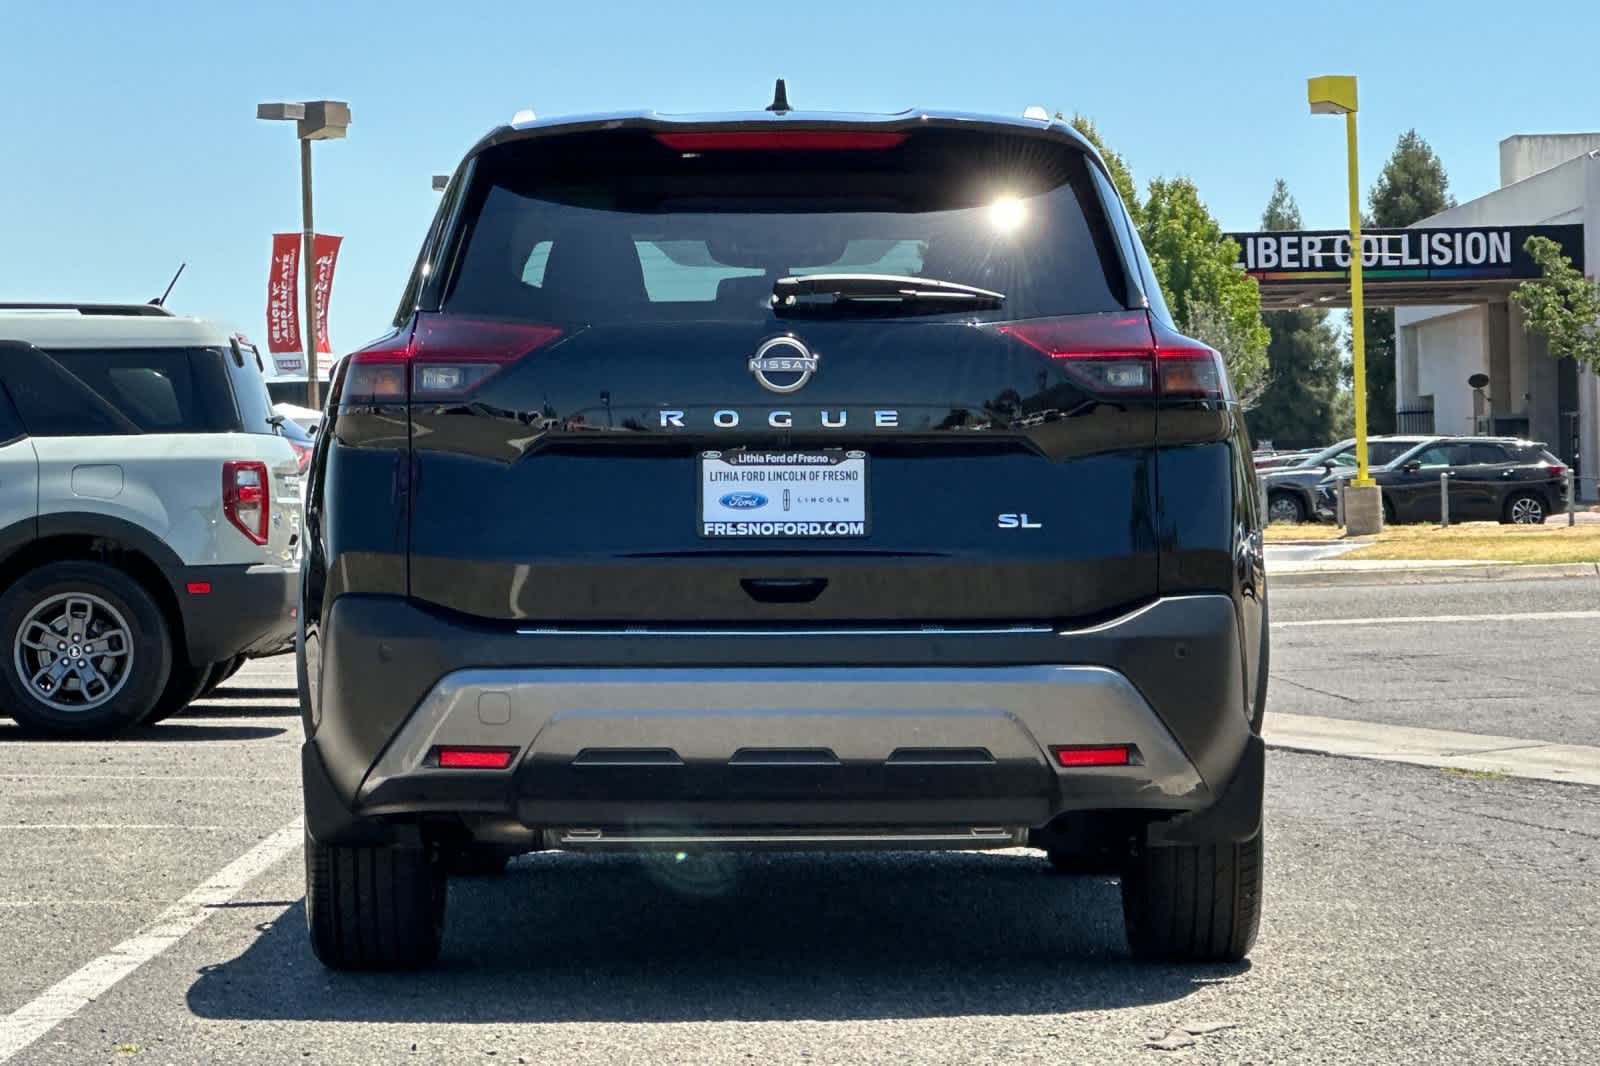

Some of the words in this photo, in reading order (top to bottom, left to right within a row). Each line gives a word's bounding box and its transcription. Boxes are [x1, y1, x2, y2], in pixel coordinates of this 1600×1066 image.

[1334, 231, 1512, 268] COLLISION
[751, 360, 815, 369] NISSAN
[659, 409, 899, 428] ROGUE
[738, 453, 764, 463] Lithia
[766, 453, 785, 463] Ford
[786, 453, 798, 463] of
[798, 454, 829, 463] Fresno
[710, 471, 739, 482] LITHIA
[741, 471, 766, 481] FORD
[768, 471, 807, 481] LINCOLN
[809, 470, 820, 481] OF
[823, 470, 858, 481] FRESNO
[796, 496, 850, 504] LINCOLN
[997, 513, 1043, 529] SL
[703, 522, 865, 536] FRESNOFORD.COM
